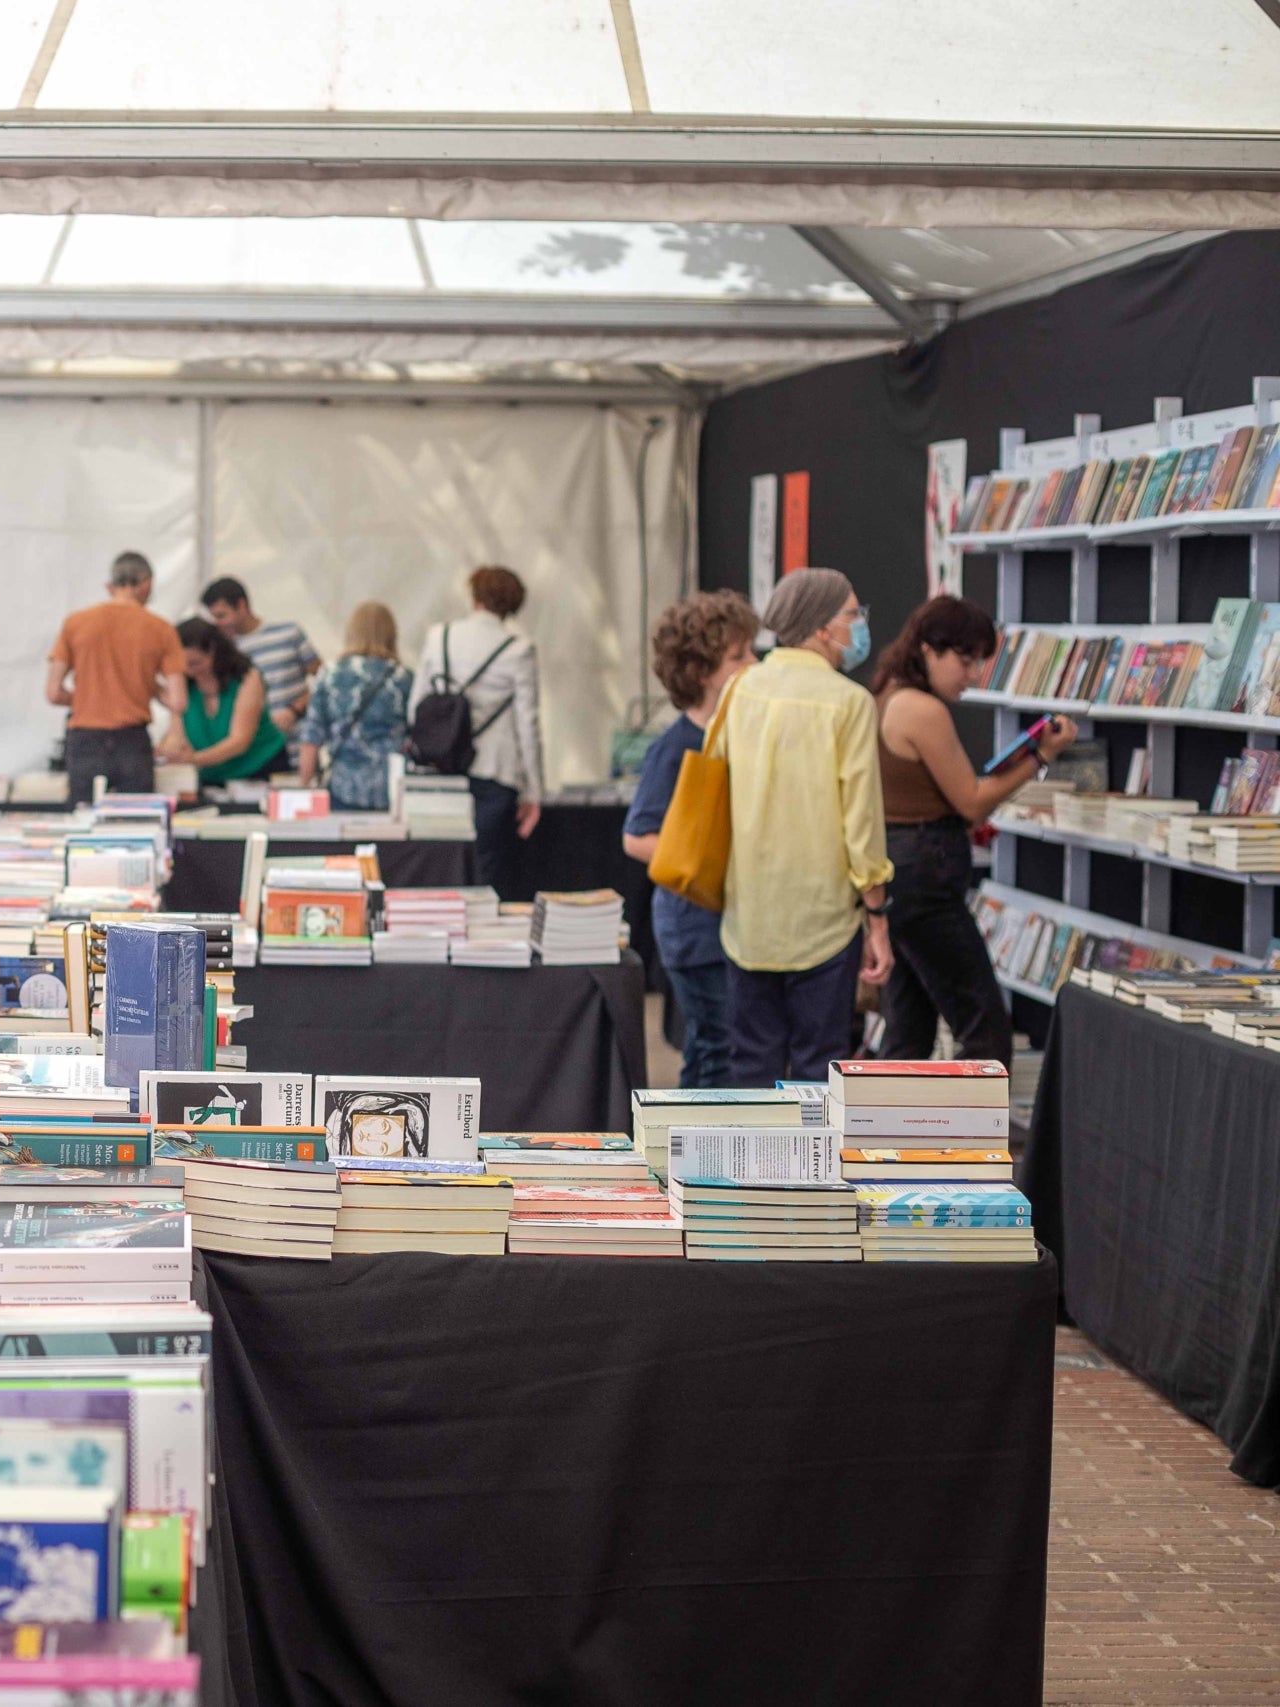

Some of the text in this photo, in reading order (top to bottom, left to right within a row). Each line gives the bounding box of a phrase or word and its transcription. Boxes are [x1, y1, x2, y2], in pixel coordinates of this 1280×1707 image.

[283, 1083, 295, 1126] oportuni
[295, 1083, 304, 1126] Darreres
[463, 1093, 474, 1139] Estribord
[813, 1137, 821, 1180] La drece
